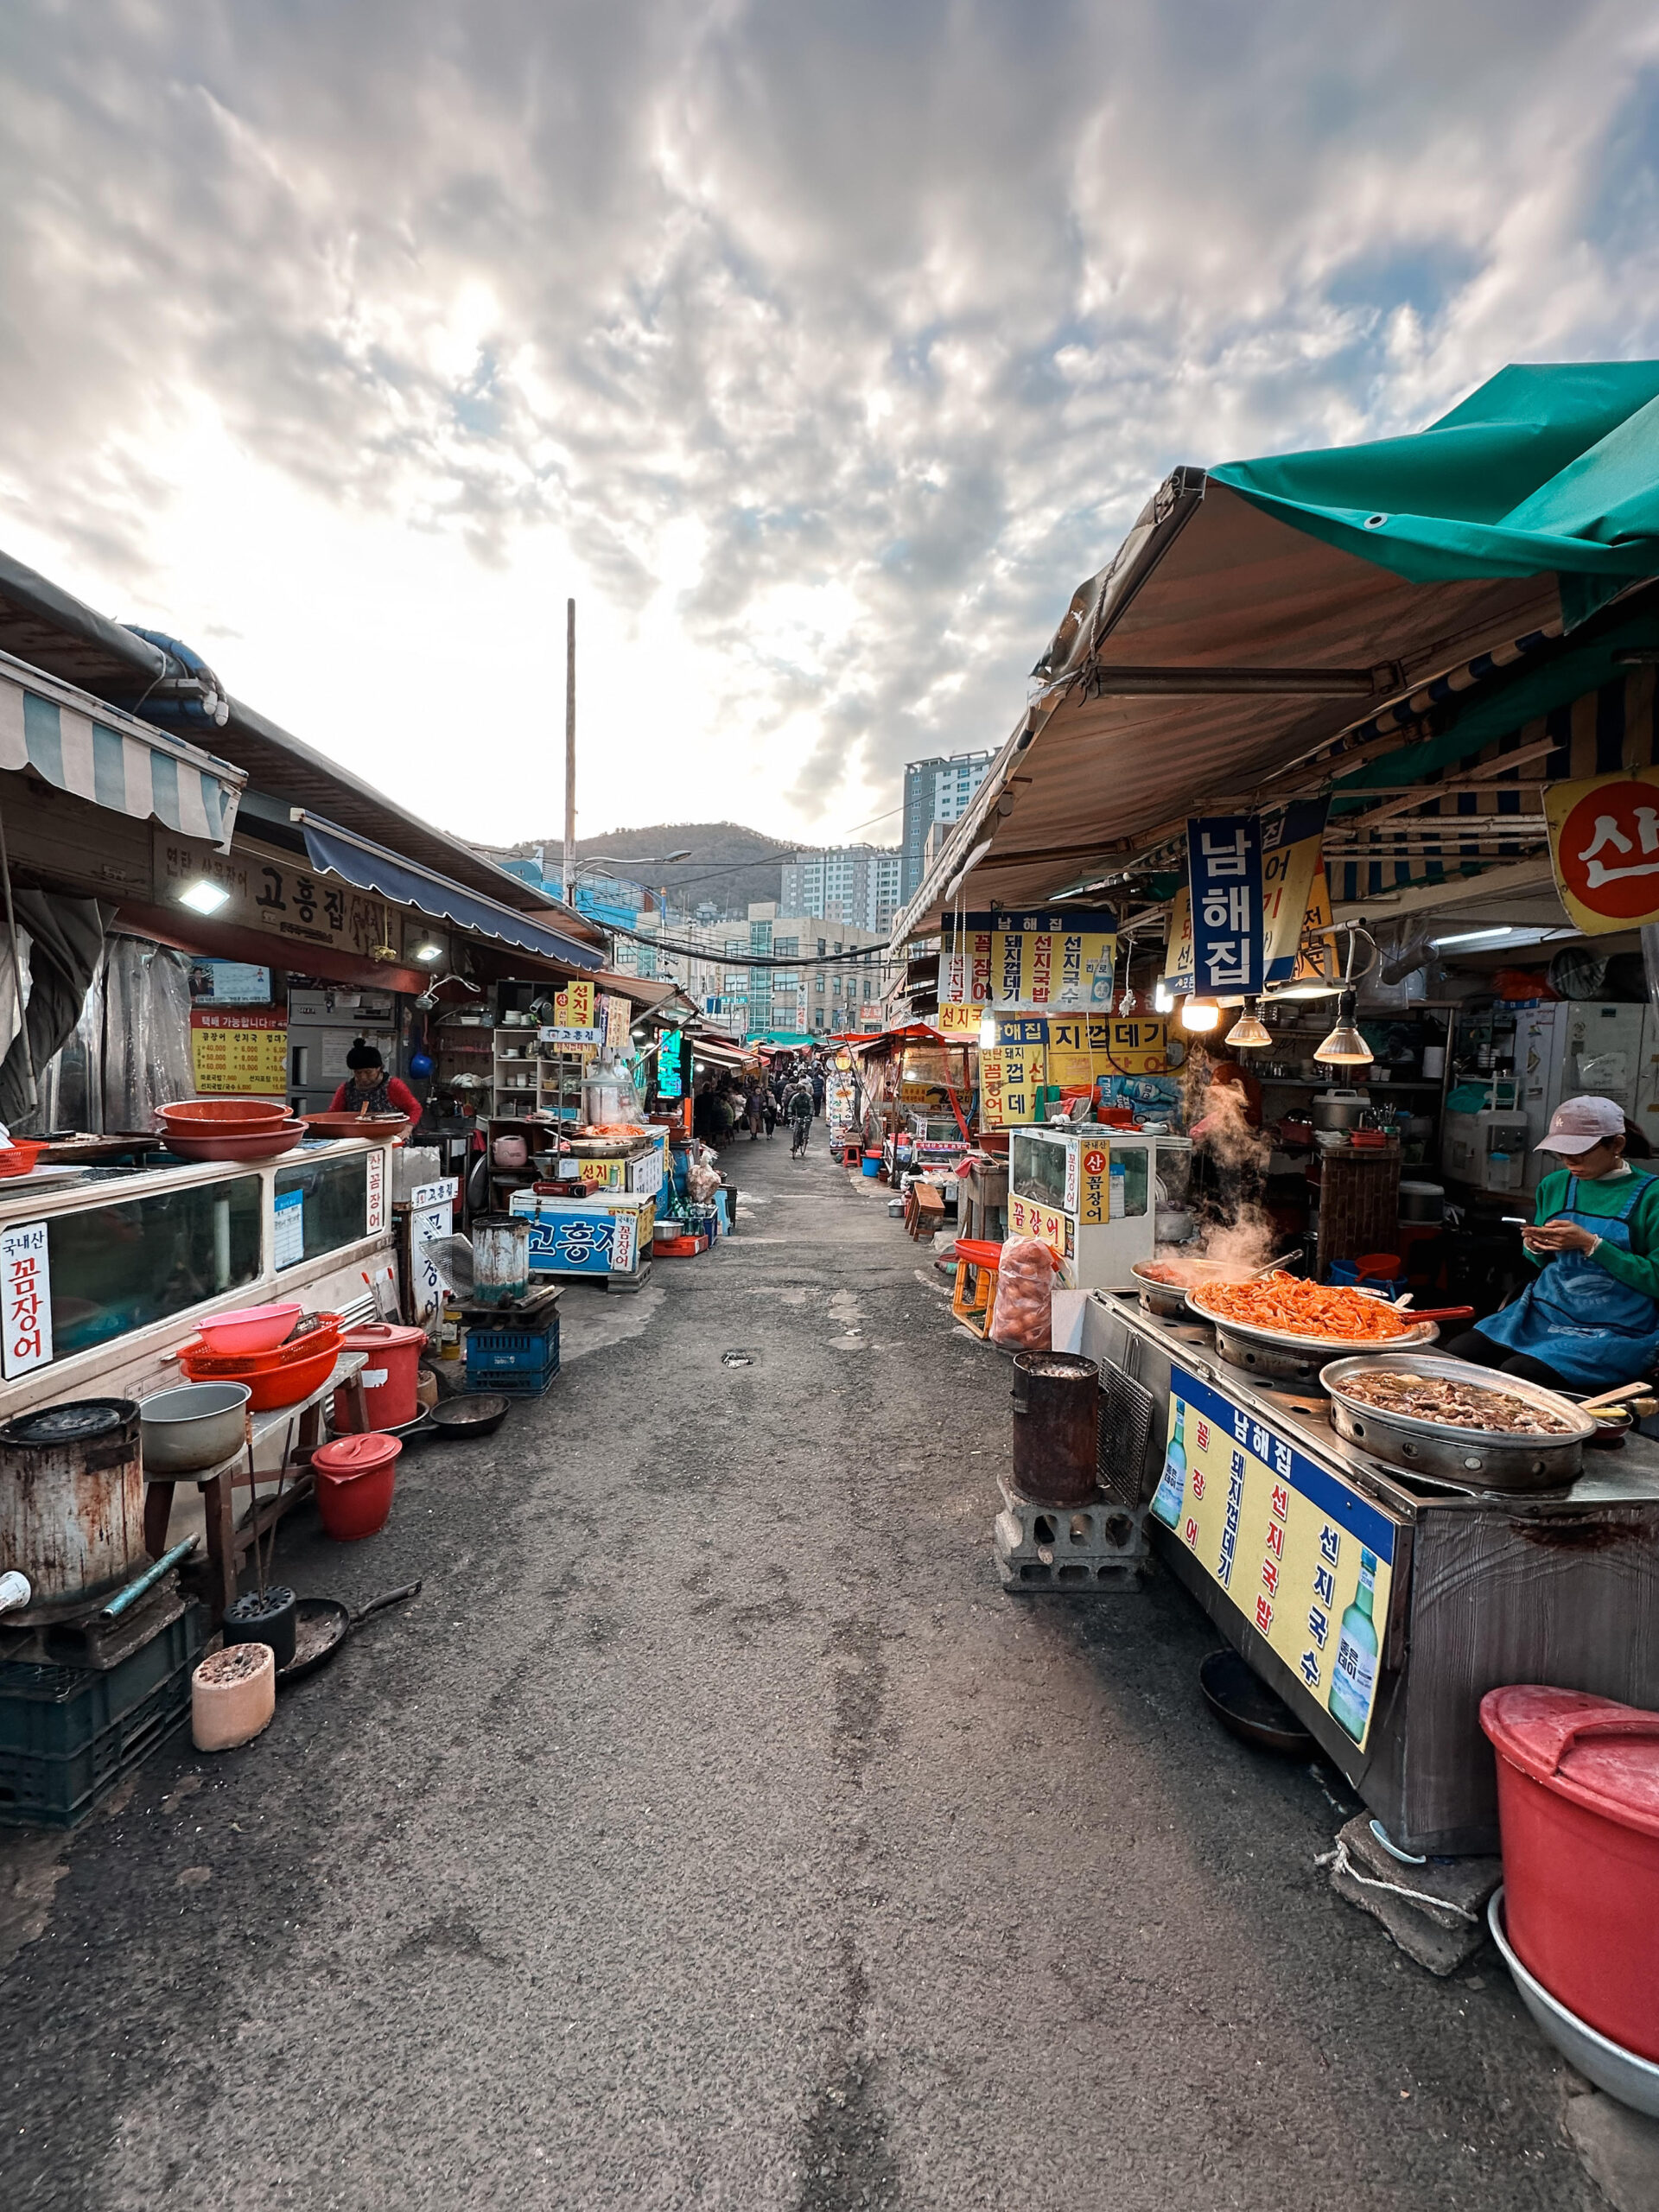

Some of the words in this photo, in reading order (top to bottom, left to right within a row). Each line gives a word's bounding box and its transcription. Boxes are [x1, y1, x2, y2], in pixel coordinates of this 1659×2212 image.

[1265, 849, 1291, 881] 어
[1578, 805, 1658, 889] 산
[256, 866, 345, 932] 고흥집
[1201, 829, 1251, 986] 남해집
[997, 917, 1063, 931] 남해집
[947, 957, 964, 1003] 선지국
[972, 934, 991, 1001] 꼼장어
[1002, 934, 1023, 1002] 돼지껍데기
[1032, 935, 1052, 1003] 선지국밥
[1061, 935, 1082, 1004] 선지국수
[1085, 963, 1109, 974] 진로
[557, 995, 568, 1006] 산
[572, 984, 589, 1026] 선지국
[223, 1016, 268, 1029] 가능합니다
[233, 1033, 258, 1043] 선지국
[561, 1029, 594, 1041] 고흥집
[1048, 1022, 1167, 1051] 지껍데기
[982, 1047, 1002, 1061] 연탄
[1004, 1046, 1024, 1060] 돼지
[1083, 1141, 1108, 1150] 국내산
[1086, 1154, 1103, 1172] 산
[428, 1182, 454, 1202] 고흥집
[582, 1164, 607, 1181] 선지
[1066, 1154, 1077, 1208] 꼼장어
[1085, 1175, 1104, 1222] 꼼장어
[3, 1230, 45, 1256] 국내산
[1013, 1201, 1059, 1248] 꼼장어
[615, 1225, 632, 1268] 꼼장어
[8, 1257, 44, 1358] 꼼장어
[1233, 1408, 1293, 1480] 남해집
[1184, 1418, 1211, 1550] 꼼장어
[1217, 1447, 1247, 1590] 돼지껍데기
[1255, 1481, 1291, 1637] 선지국밥
[1298, 1521, 1341, 1688] 선지국수
[1338, 1650, 1357, 1681] 데이
[1340, 1637, 1359, 1664] 좋은
